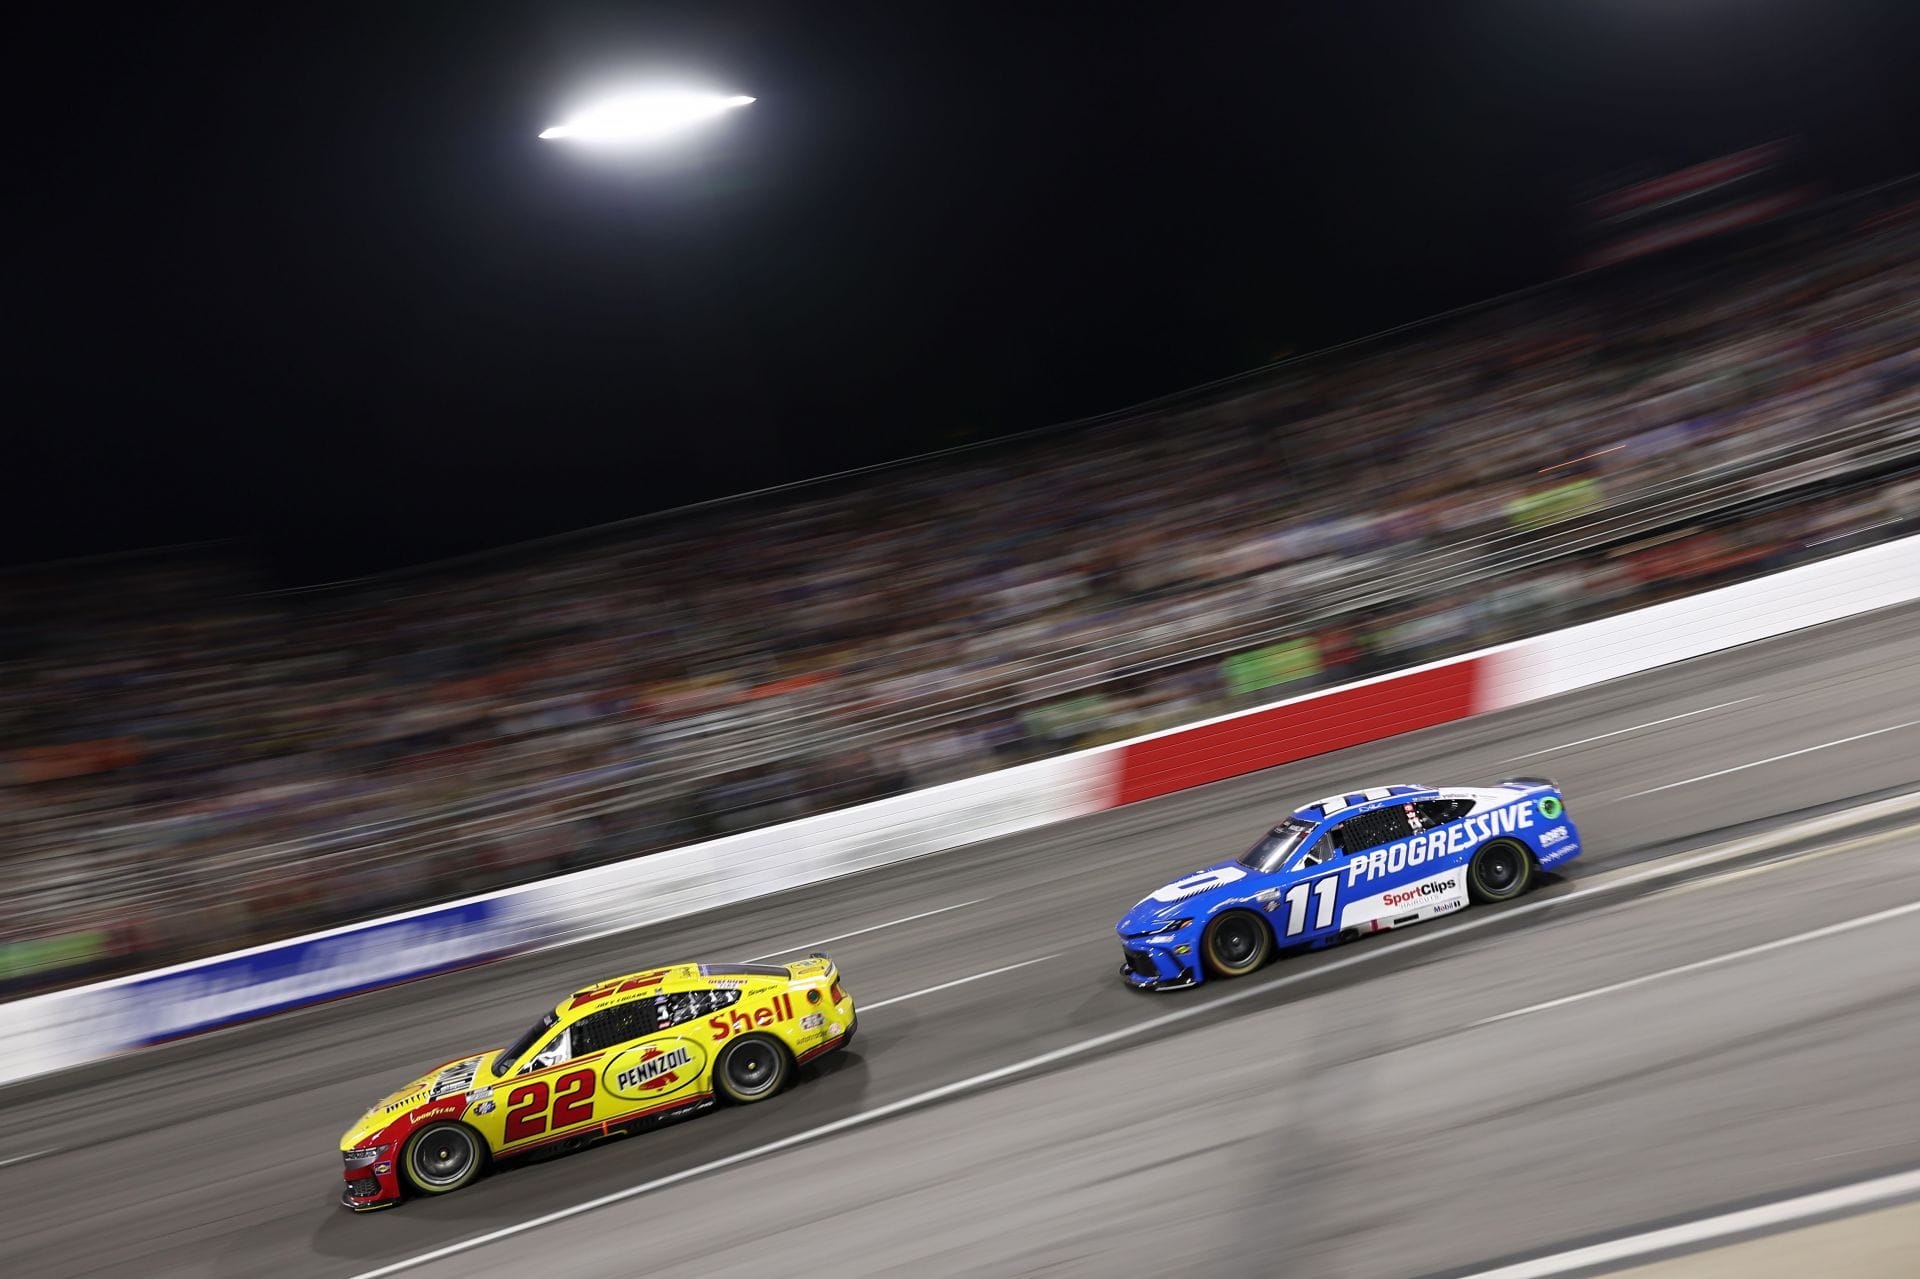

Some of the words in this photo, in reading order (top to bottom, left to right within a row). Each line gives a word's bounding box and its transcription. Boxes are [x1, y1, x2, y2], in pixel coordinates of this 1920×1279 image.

[1348, 801, 1534, 888] PROGRESSIVE
[1285, 874, 1340, 938] 11
[1383, 878, 1457, 906] SportClips
[1433, 902, 1454, 914] Mobil
[708, 992, 794, 1042] Shell
[617, 1046, 692, 1092] PENNZOIL
[504, 1068, 596, 1145] 22
